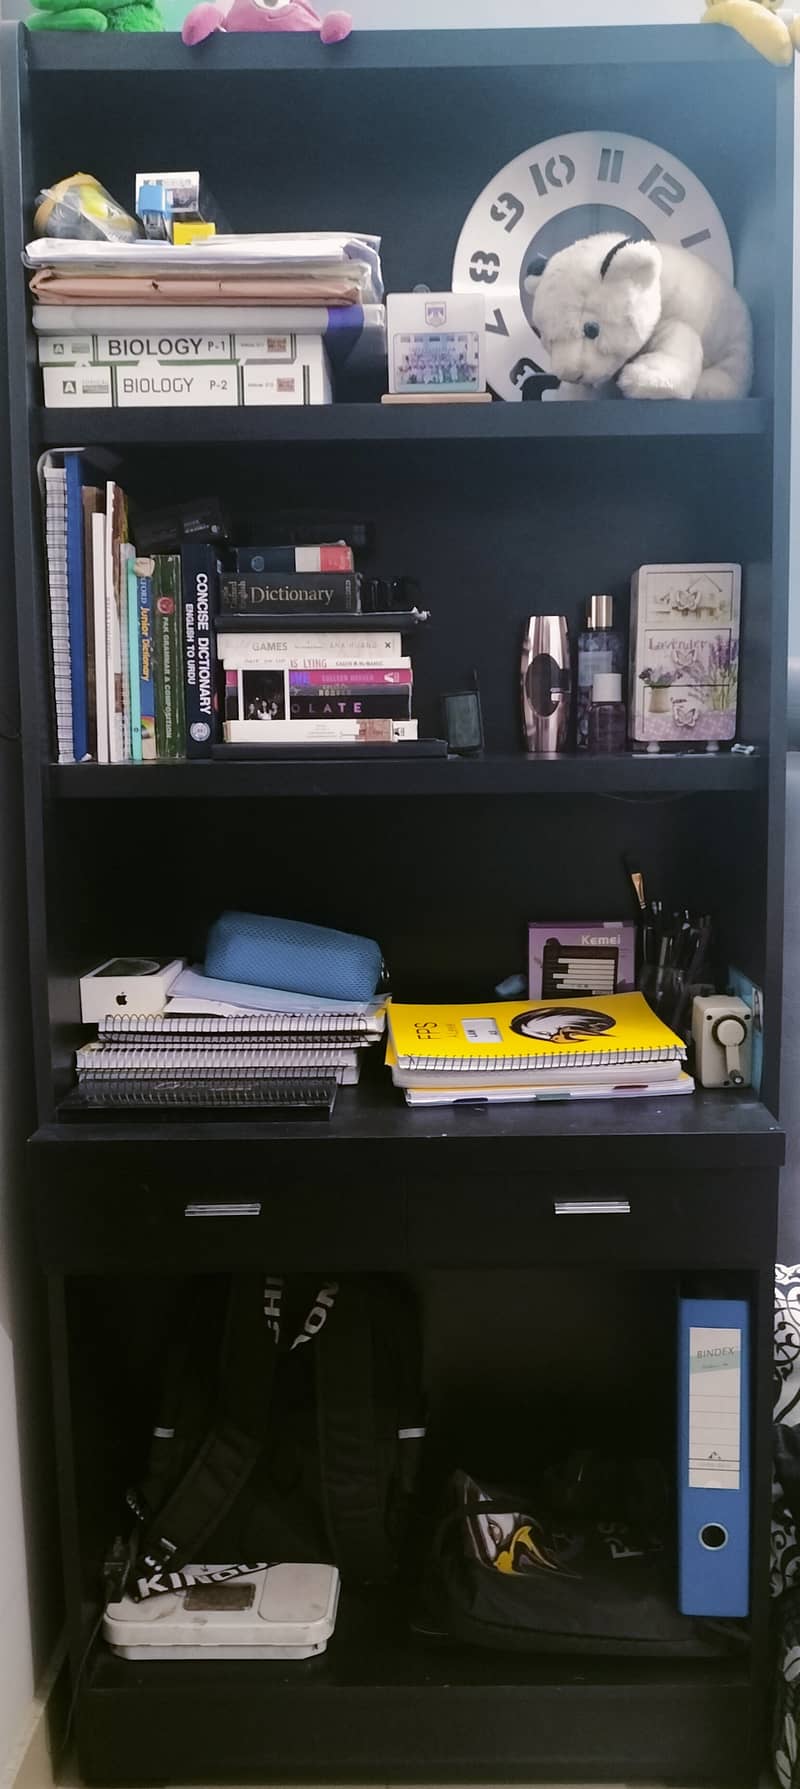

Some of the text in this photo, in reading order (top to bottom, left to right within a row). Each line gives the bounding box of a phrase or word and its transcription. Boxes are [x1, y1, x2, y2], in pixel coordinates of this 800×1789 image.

[529, 154, 576, 196] 10
[638, 163, 686, 217] 12
[490, 192, 525, 233] 9
[469, 250, 500, 284] 8
[484, 308, 510, 338] 7
[108, 337, 203, 356] BIOLOGY
[207, 340, 226, 352] P-1
[122, 377, 194, 393] BIOLOGY
[209, 379, 228, 391] P-2
[250, 585, 334, 605] Dictionary
[140, 577, 150, 681] FORD Junior Dictionary
[185, 603, 196, 685] ENGLISH TO URDU
[196, 572, 212, 715] CONCISE DICTIONARY
[163, 634, 171, 675] GRAMMAR
[252, 641, 288, 652] GAMES
[290, 659, 299, 668] IS
[303, 658, 328, 668] LYING
[164, 684, 172, 738] COMPOSITION
[290, 702, 363, 714] OLATE
[581, 934, 621, 945] Kemei
[414, 1021, 441, 1040] FPS
[696, 1346, 736, 1360] BINDEX
